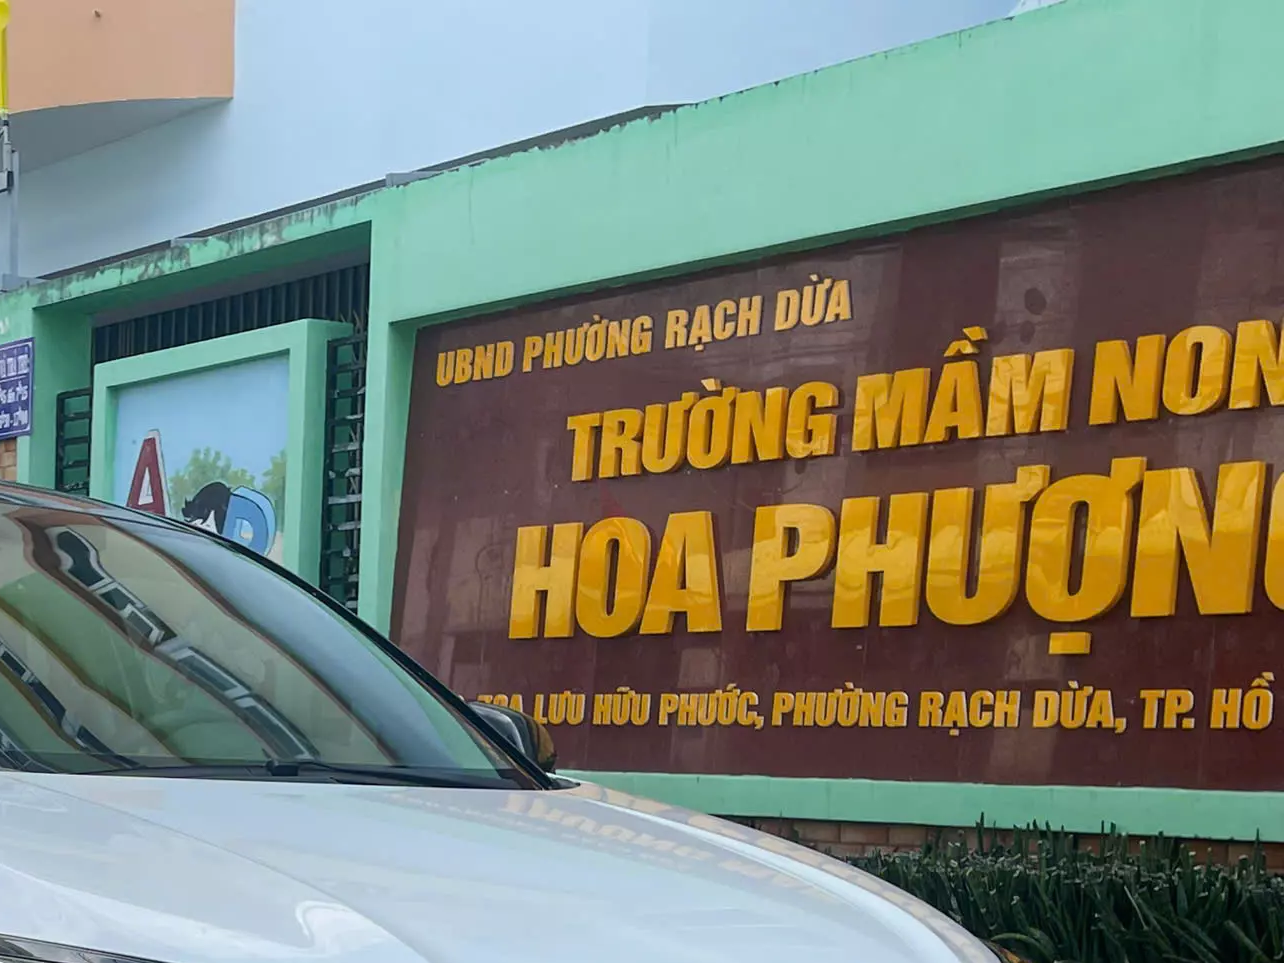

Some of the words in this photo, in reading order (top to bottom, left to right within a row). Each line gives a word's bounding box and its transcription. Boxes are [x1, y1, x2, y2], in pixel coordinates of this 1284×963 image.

[435, 340, 515, 388] UBND
[521, 314, 653, 373] PHƯỜNG
[664, 295, 763, 351] RẠCH
[774, 274, 853, 331] DỪA
[567, 378, 840, 482] TRƯỜNG
[851, 326, 1075, 452] MẦM
[1088, 319, 1284, 426] NON
[508, 510, 722, 640] HOA
[745, 456, 1284, 655] PHƯỢN
[533, 690, 585, 726] LƯU
[592, 687, 650, 726] HỮU
[658, 683, 765, 731] PHƯỚC,
[771, 682, 909, 728] PHƯỜNG
[918, 689, 1021, 737] RẠCH
[1032, 680, 1128, 734] DỪA,
[1140, 688, 1196, 730] TP.
[1209, 671, 1276, 731] HỒ
